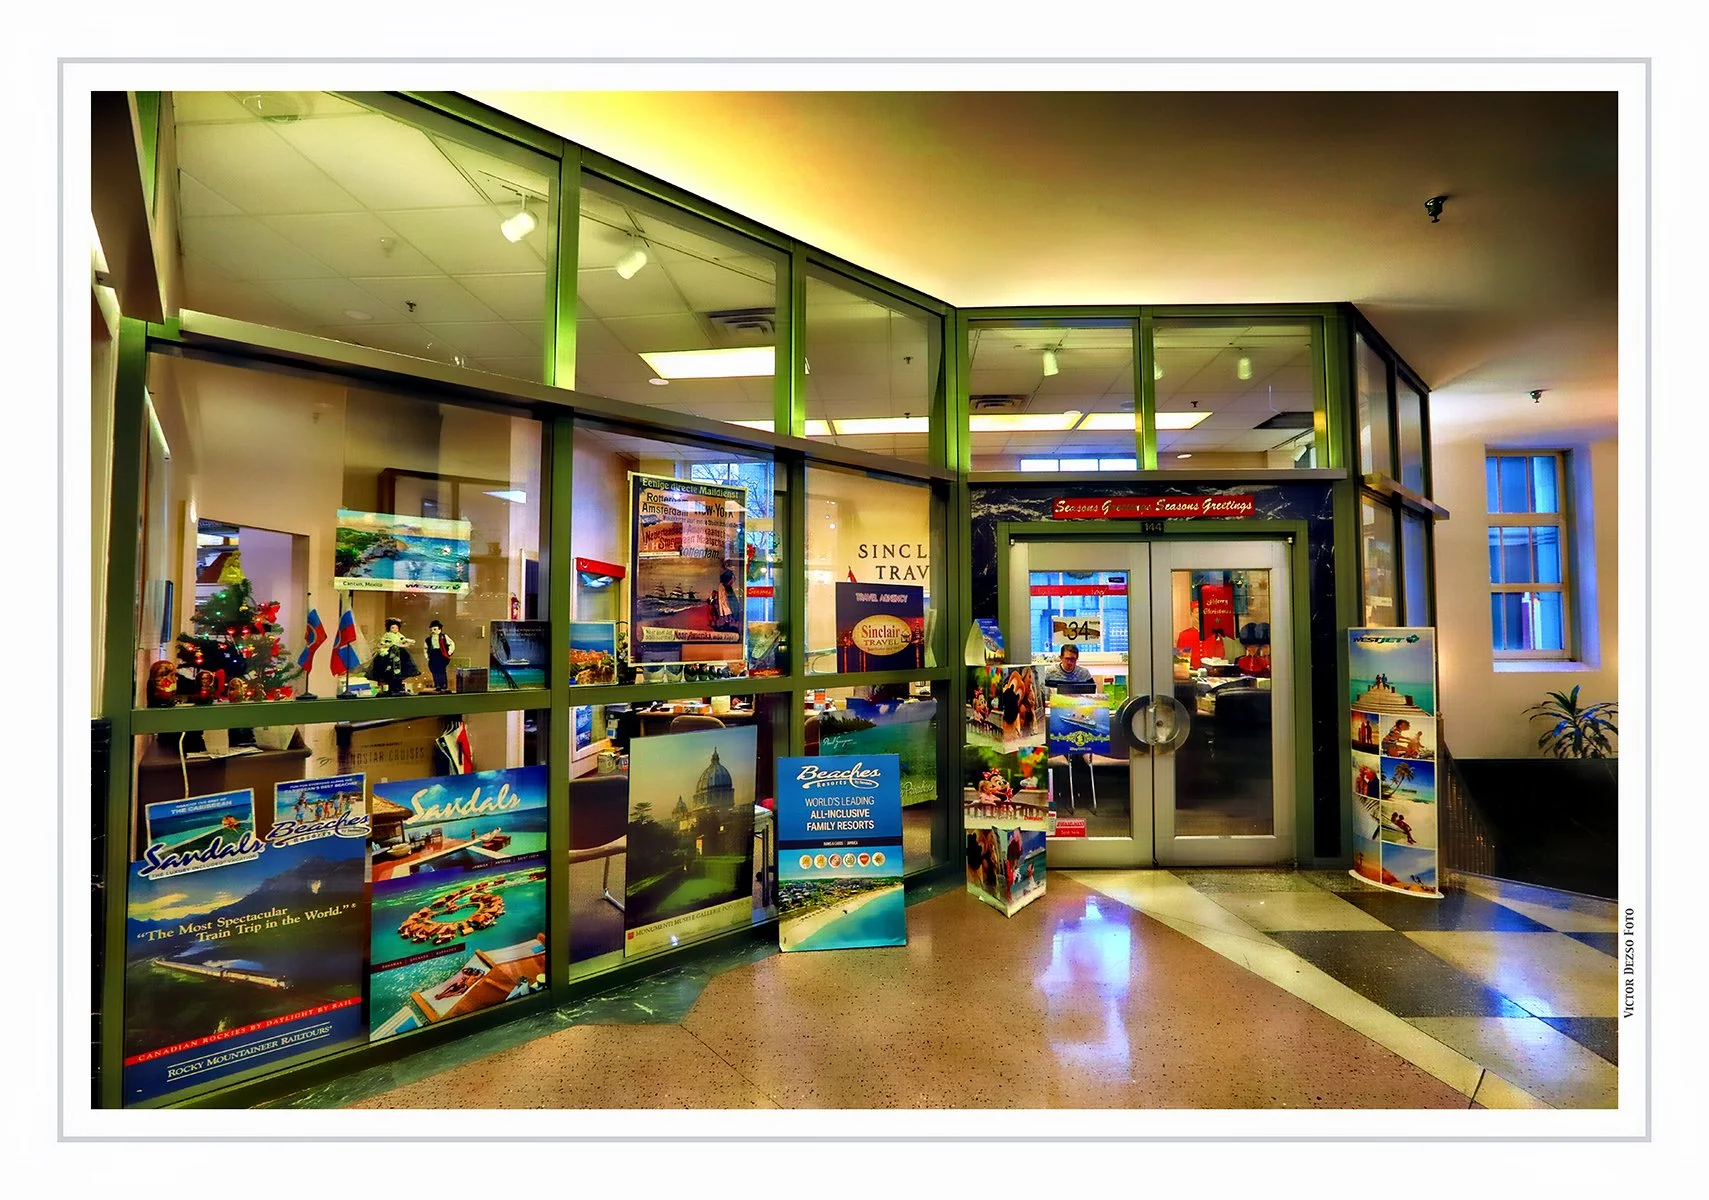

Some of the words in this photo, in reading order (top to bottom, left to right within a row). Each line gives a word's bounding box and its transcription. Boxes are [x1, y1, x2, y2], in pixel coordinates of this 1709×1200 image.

[642, 503, 688, 516] Amsterdam
[1055, 500, 1098, 513] Seasons
[1156, 499, 1200, 512] Seasons
[1202, 498, 1252, 515] Greetings
[1145, 522, 1163, 532] 144
[856, 592, 878, 602] TRAVEL
[862, 624, 900, 639] Sinclair
[1068, 621, 1090, 640] 34
[796, 762, 881, 781] Beaches
[402, 783, 521, 825] Sandals
[804, 796, 840, 807] WORLD'S
[842, 796, 875, 806] LEADING
[810, 808, 870, 819] ALL-INCLUSIVE
[266, 811, 369, 839] Beaches
[806, 821, 836, 832] FAMILY
[837, 820, 875, 830] RESORTS
[140, 832, 264, 876] Sandals
[179, 922, 213, 936] Most
[217, 906, 288, 928] Spectacular
[197, 928, 231, 943] Train
[236, 922, 262, 936] Trip
[266, 918, 278, 929] in
[282, 914, 300, 926] the
[138, 1039, 198, 1061] CANADIAN
[202, 1027, 246, 1044] ROCKIES
[250, 1022, 262, 1032] BY
[266, 1009, 314, 1028] DAYLIGHT
[318, 1004, 328, 1014] BY
[332, 1000, 352, 1010] RAIL
[168, 1061, 204, 1078] ROCKY
[206, 1041, 278, 1066] MOUNTAINEER
